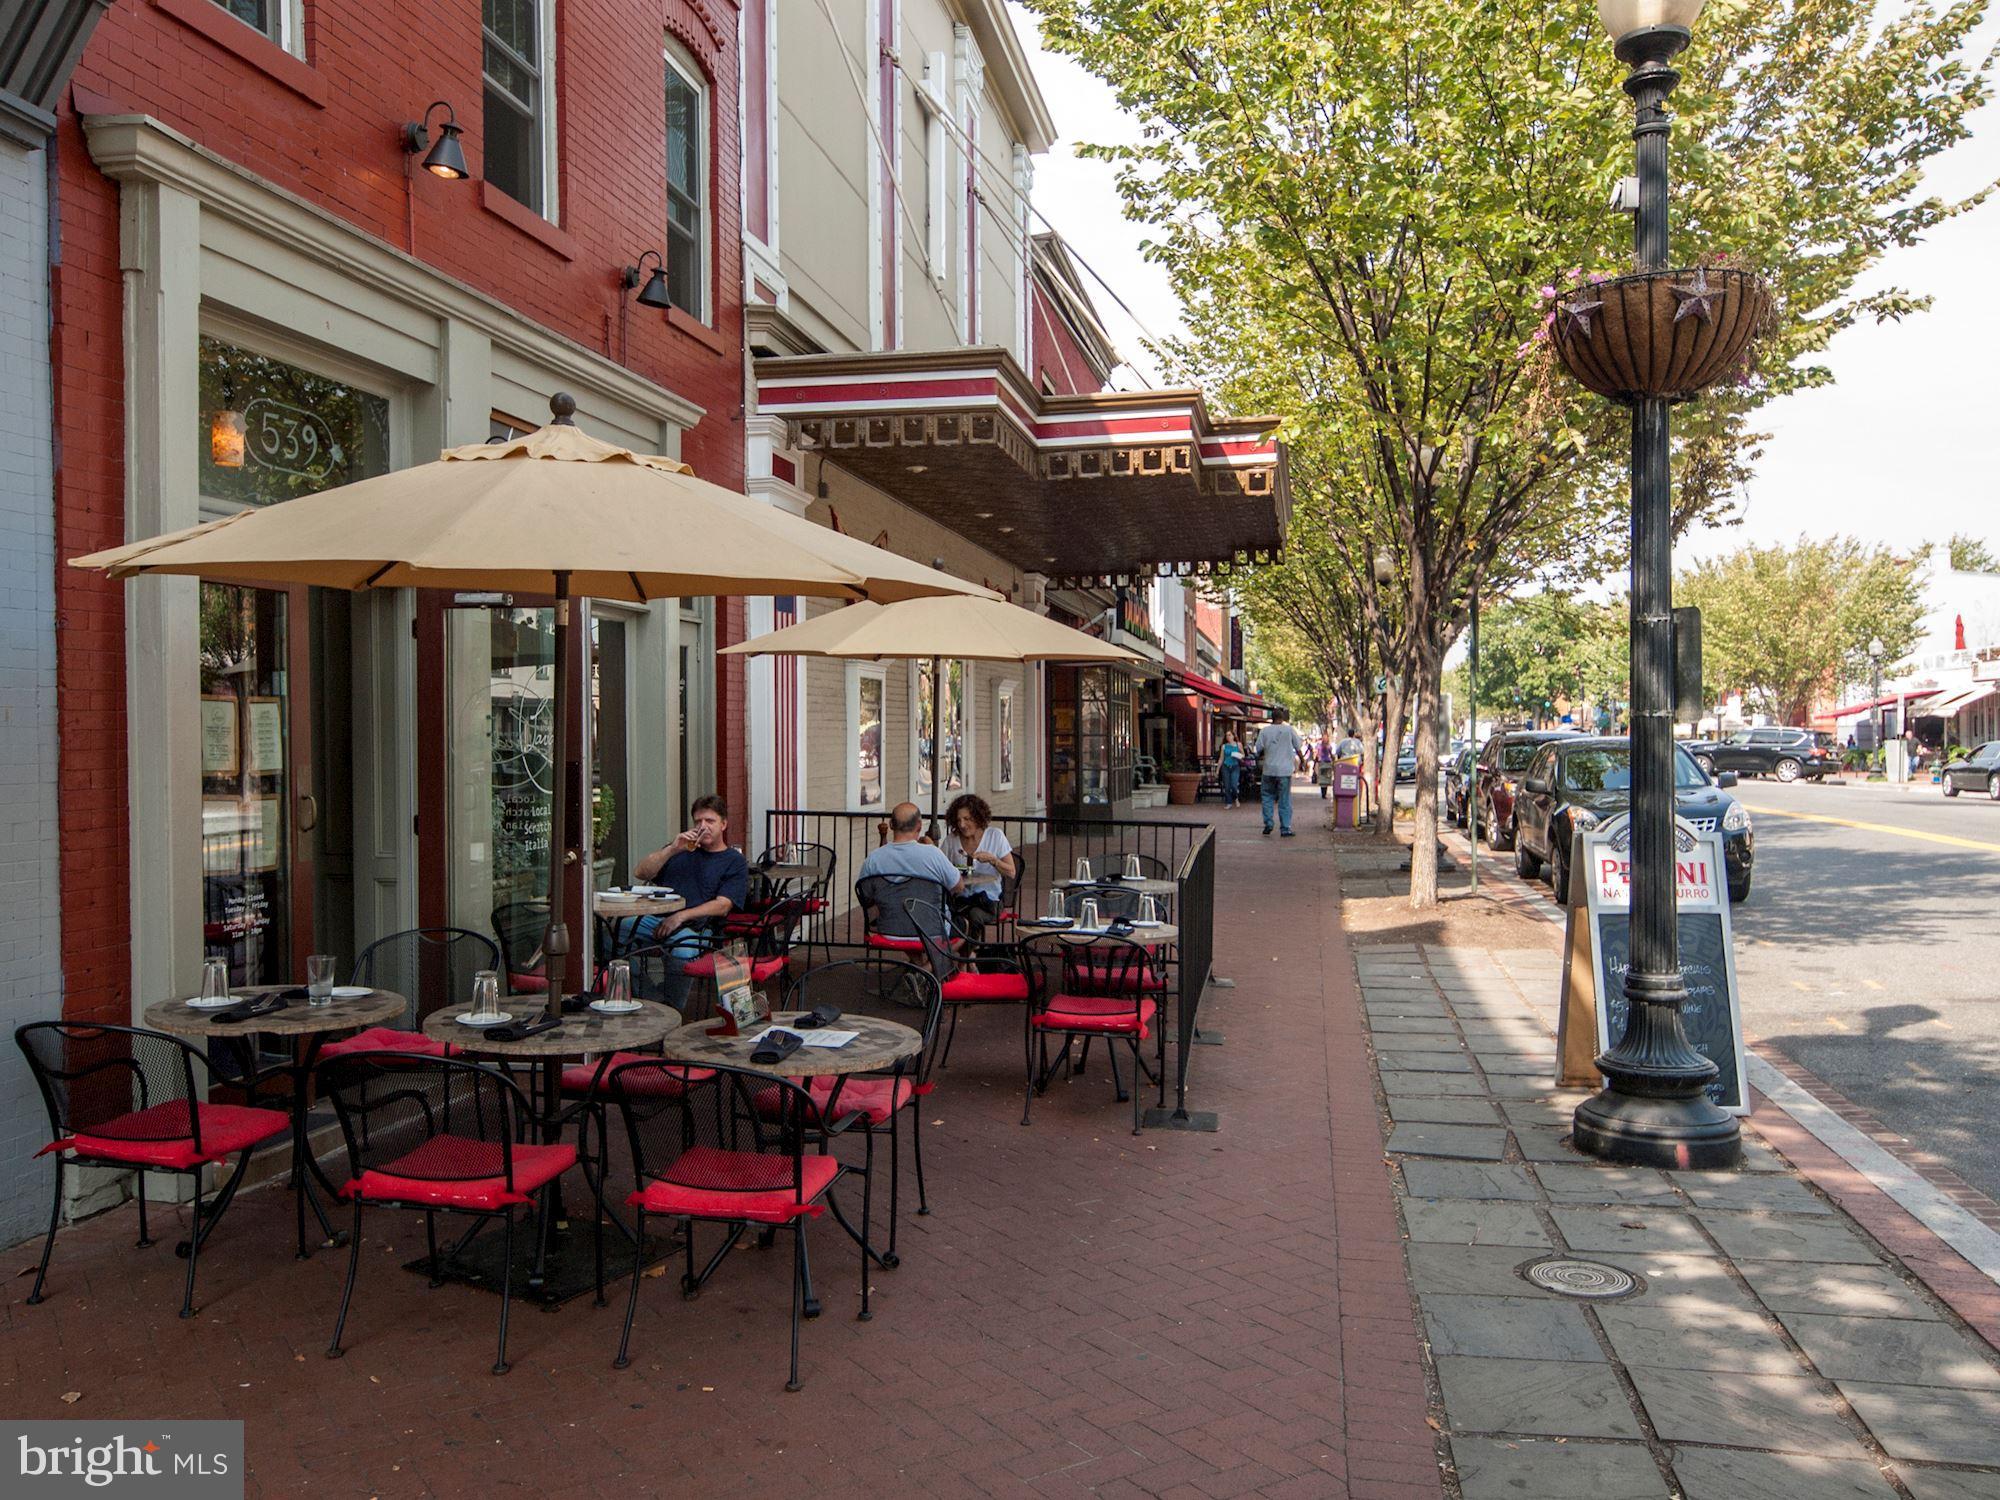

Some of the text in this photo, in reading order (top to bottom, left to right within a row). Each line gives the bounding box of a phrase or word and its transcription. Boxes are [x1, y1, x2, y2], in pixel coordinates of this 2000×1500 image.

[261, 412, 318, 466] 539
[532, 803, 551, 817] Local
[524, 821, 552, 835] Scratch
[1601, 859, 1708, 886] PENI
[1676, 888, 1709, 899] URRO
[225, 905, 245, 914] Tuesday
